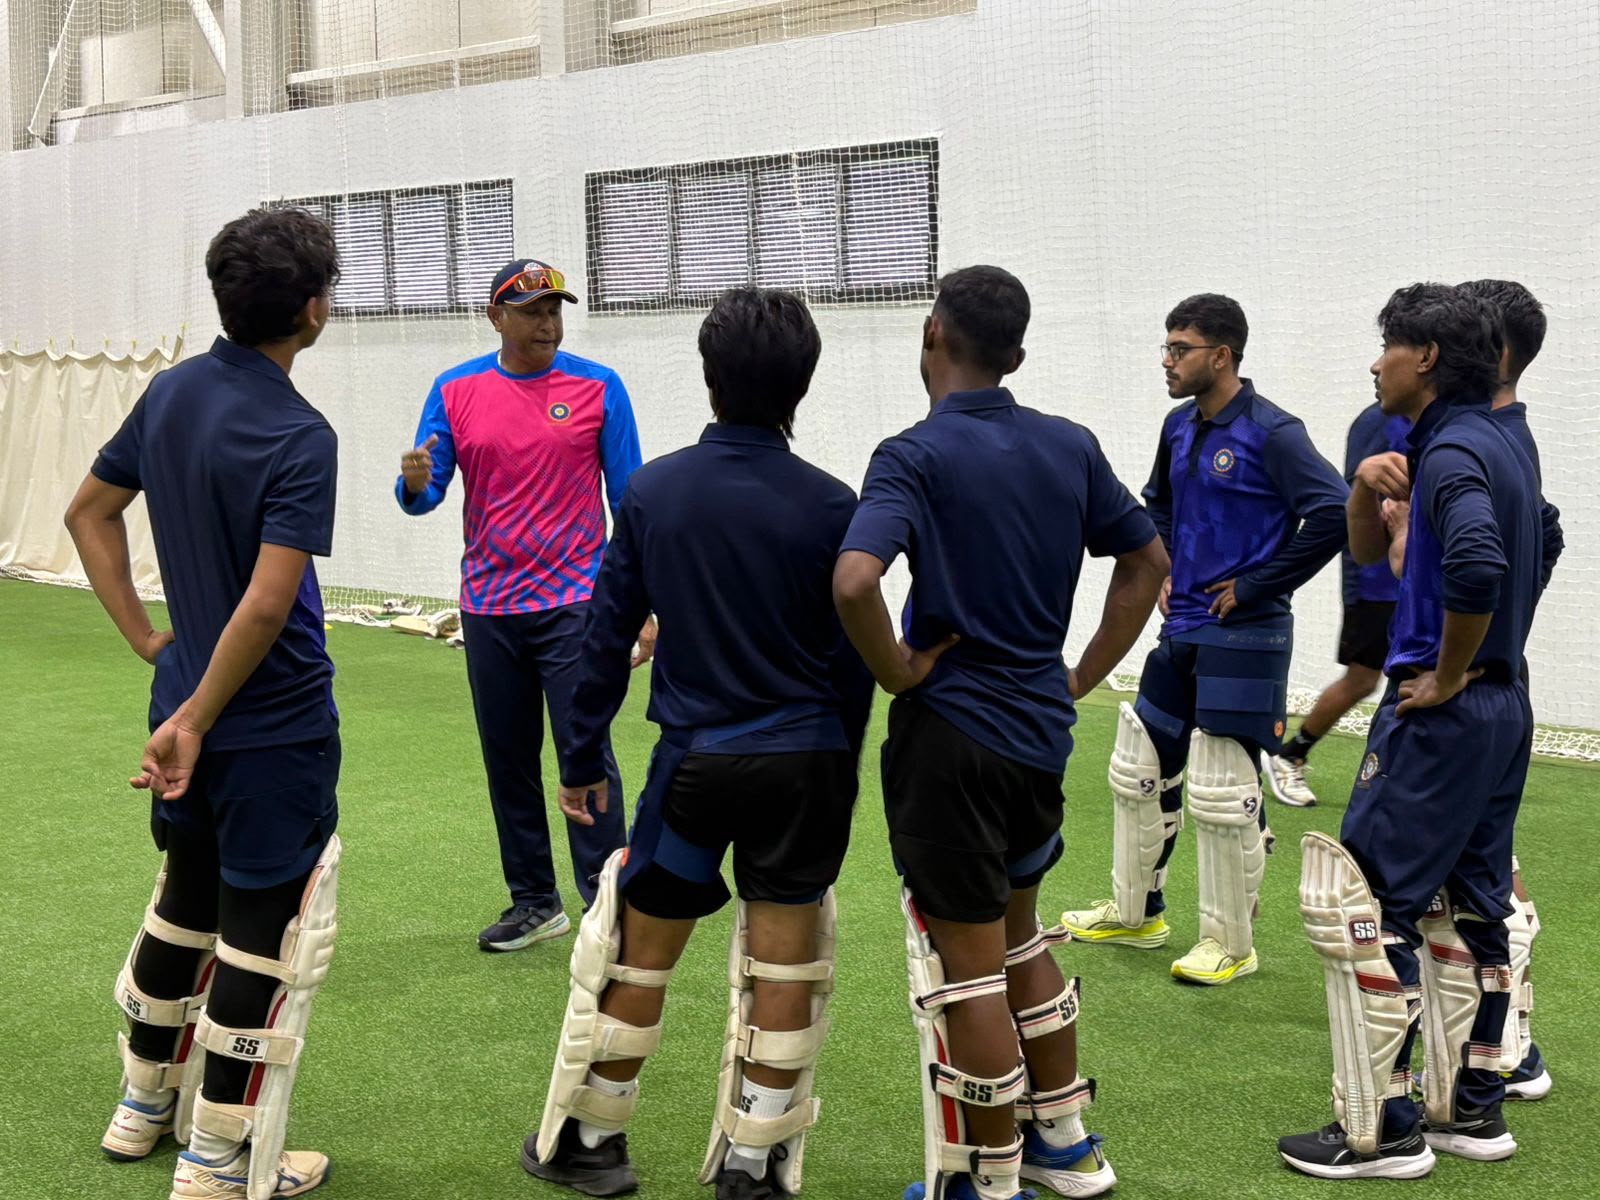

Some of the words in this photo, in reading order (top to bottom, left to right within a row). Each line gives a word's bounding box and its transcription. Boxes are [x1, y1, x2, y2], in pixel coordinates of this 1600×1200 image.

[1353, 921, 1377, 940] SS
[126, 993, 142, 1017] SS
[1058, 993, 1077, 1021] SS
[232, 1036, 260, 1056] SS
[962, 1080, 993, 1103] SS
